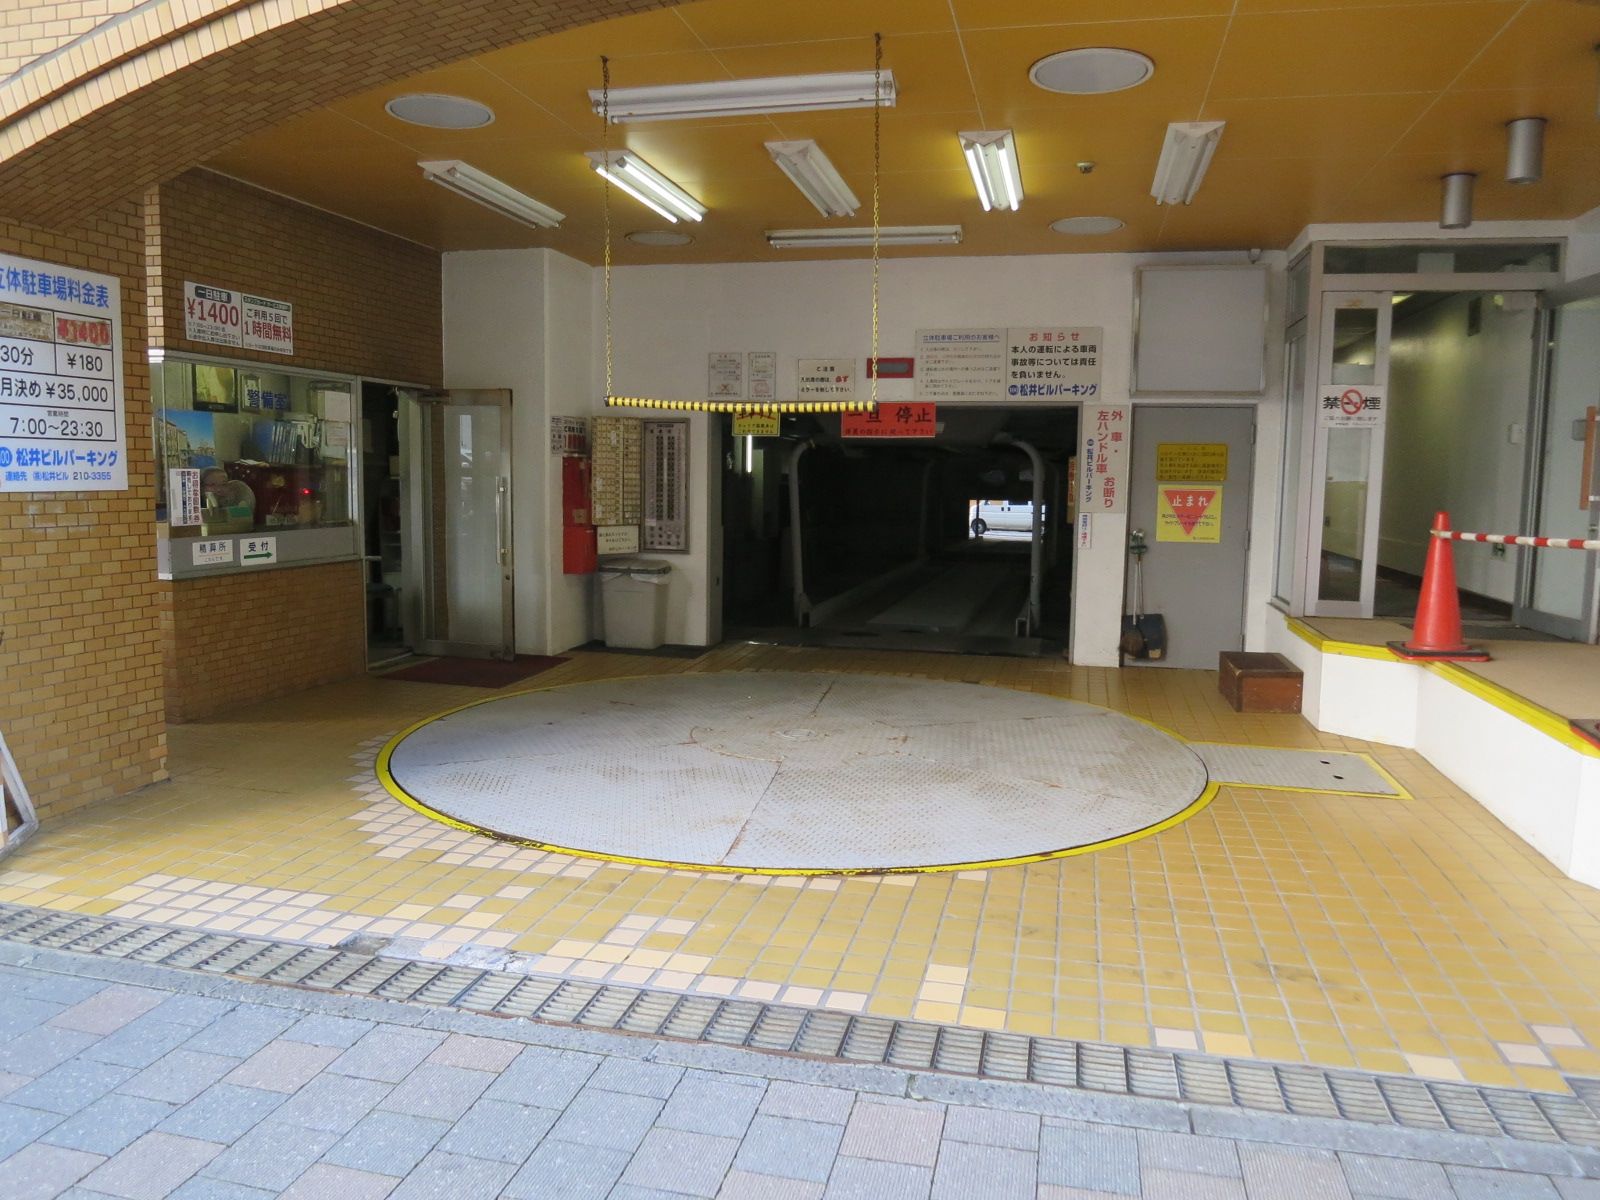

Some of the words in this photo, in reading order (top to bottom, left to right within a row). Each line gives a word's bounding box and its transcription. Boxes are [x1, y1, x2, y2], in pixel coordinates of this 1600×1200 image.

[187, 297, 239, 327] ¥1400
[244, 321, 292, 343] 1時間無料
[1028, 333, 1081, 342] お知らせ
[0, 345, 34, 366] 30分
[67, 352, 103, 372] ¥180
[1011, 345, 1097, 354] 本人の運転による車両
[1011, 358, 1097, 367] 事故等については責任
[1011, 370, 1067, 379] を負いません。
[0, 377, 41, 398] 月決め
[45, 381, 108, 402] ¥35,000
[1019, 383, 1098, 397] 松井ビルパーキング
[246, 389, 288, 410] 警備室
[1323, 396, 1341, 409] 禁
[1363, 396, 1381, 410] 煙
[895, 405, 932, 424] 停止
[10, 416, 104, 438] 7:00~23:30
[1095, 410, 1110, 474] 左ハンドル車
[16, 447, 118, 467] 松井ビルパーキング
[73, 471, 112, 481] 210-3355
[1103, 476, 1116, 508] お断り
[1172, 495, 1209, 507] 止まれ
[248, 541, 269, 552] 受付
